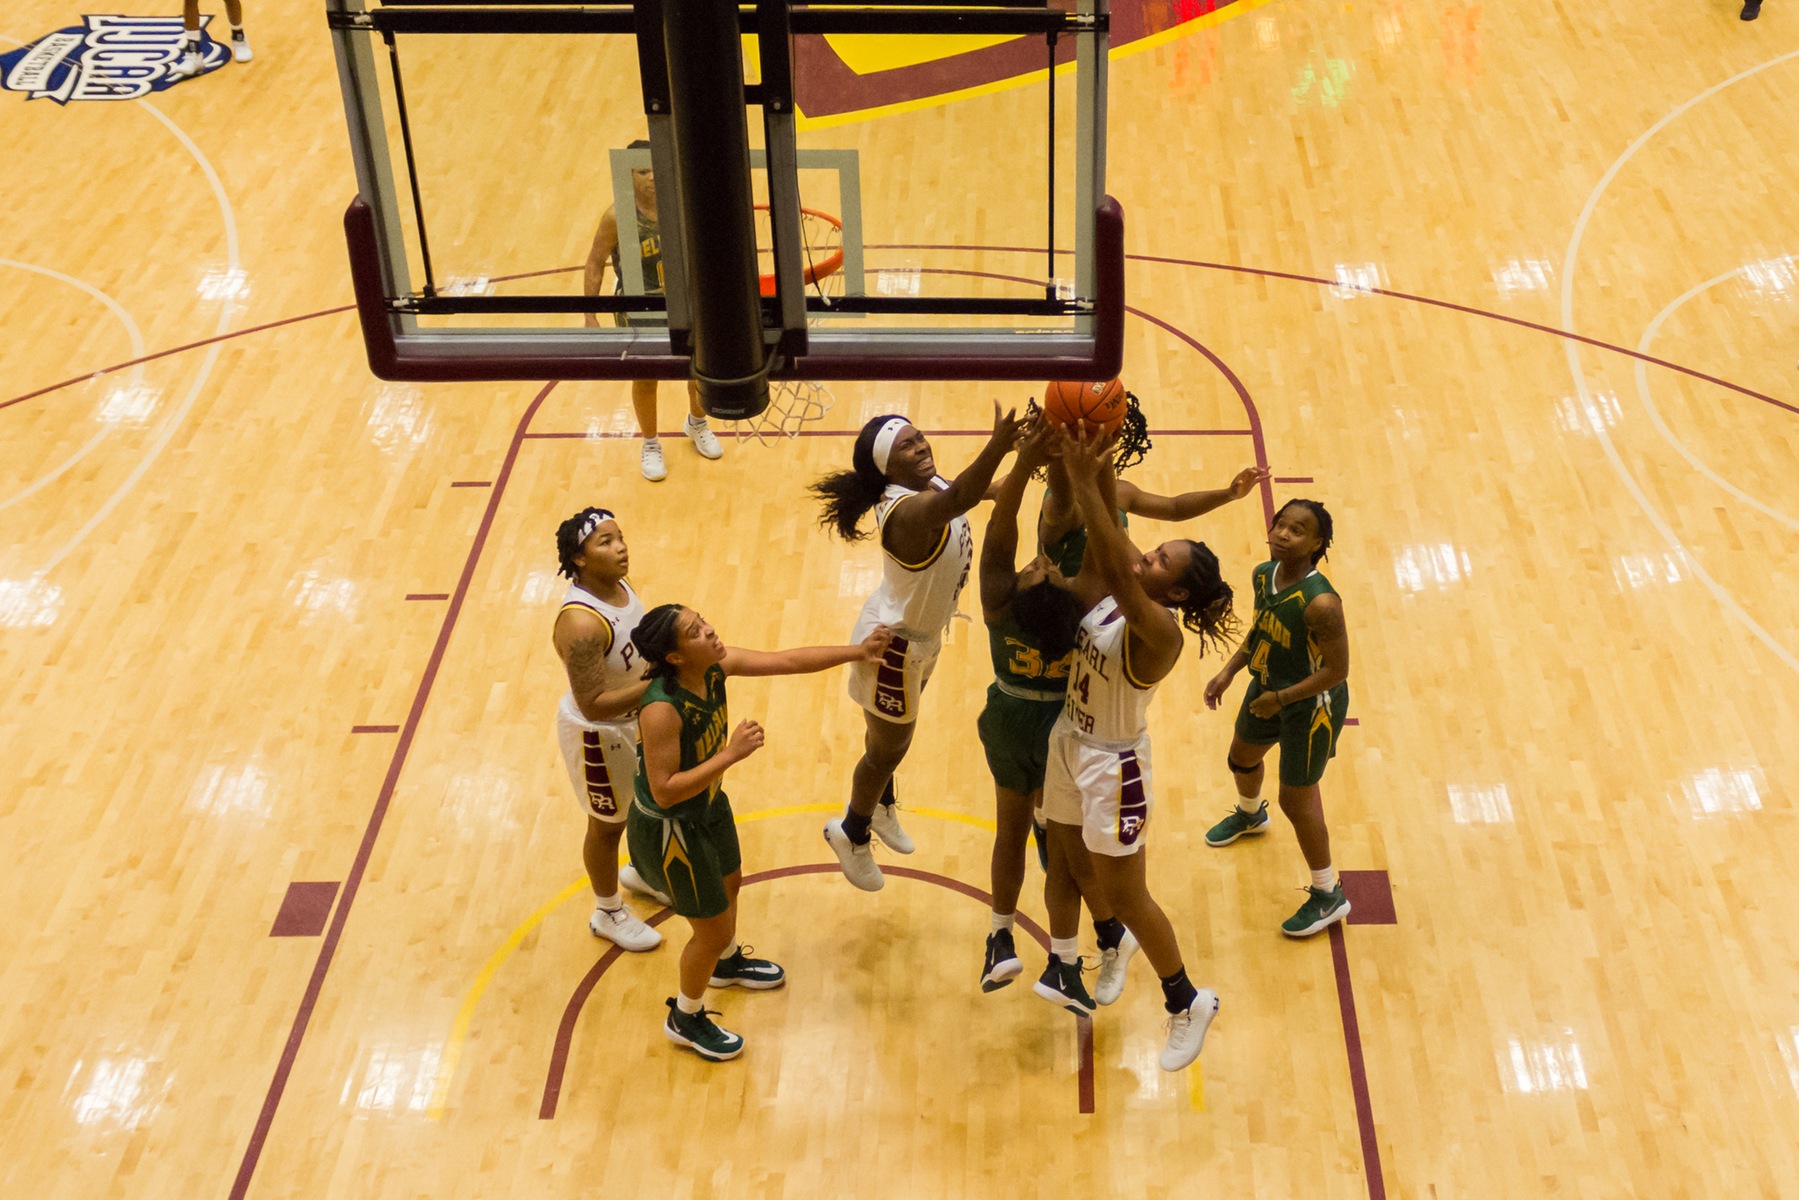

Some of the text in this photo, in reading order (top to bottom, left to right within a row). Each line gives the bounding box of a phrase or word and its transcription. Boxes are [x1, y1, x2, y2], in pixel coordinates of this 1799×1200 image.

[16, 37, 75, 86] BASKETBALL
[1077, 626, 1109, 681] EARL
[1250, 639, 1271, 685] 4
[1072, 662, 1091, 705] 14
